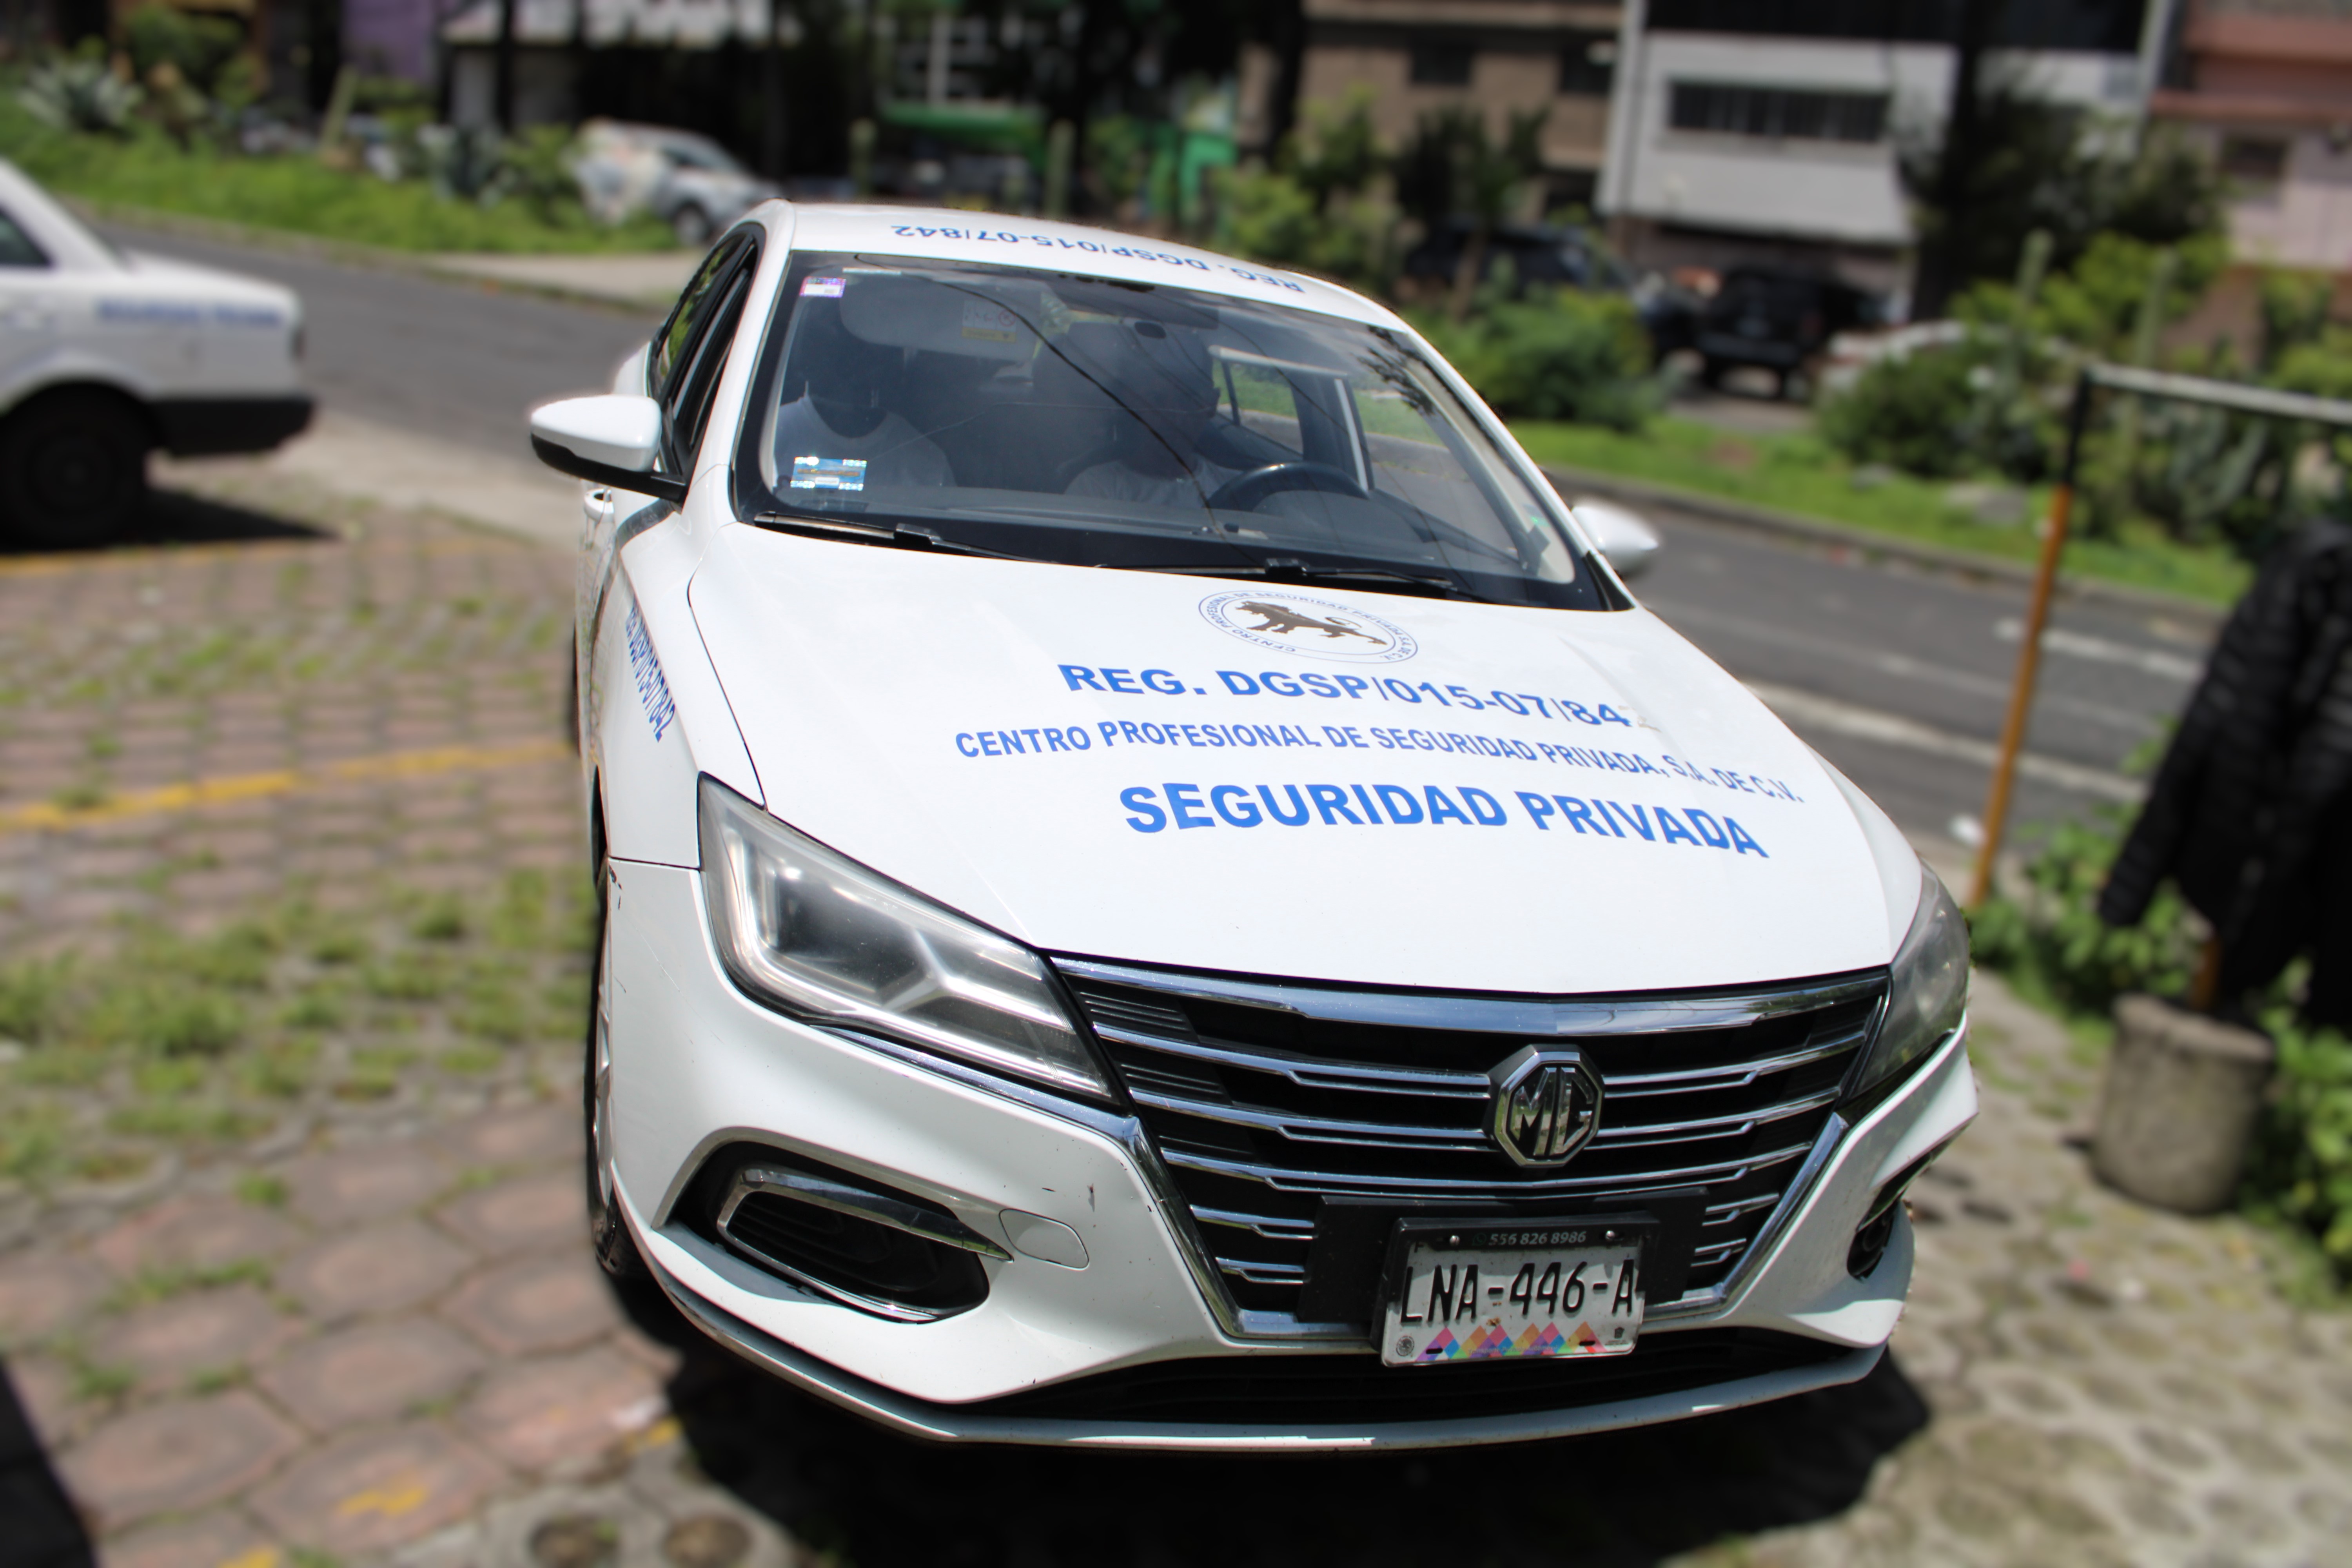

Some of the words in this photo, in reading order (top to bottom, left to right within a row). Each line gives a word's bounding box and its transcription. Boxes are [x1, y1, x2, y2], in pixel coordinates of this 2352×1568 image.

[890, 225, 1210, 270] DGSP/015-07/842
[1218, 263, 1305, 293] REG.
[1058, 664, 1207, 695] REG.
[1216, 671, 1662, 733] DGSP/015-07/84
[956, 726, 1091, 757] CENTRO
[1097, 720, 1322, 746] PROFESIONAL
[1321, 726, 1370, 748] DE
[1370, 728, 1538, 760] SEGURIDAD
[1535, 742, 1671, 777] PRIVADA,
[1662, 755, 1719, 786] S.A.
[1710, 768, 1756, 793] DE
[1749, 775, 1805, 802] C.V.
[1120, 783, 1508, 833] SEGURIDAD
[1514, 791, 1770, 858] PRIVADA
[1510, 1067, 1594, 1156] MG
[1488, 1233, 1517, 1245] 556
[1520, 1232, 1548, 1245] 826
[1550, 1231, 1587, 1244] 8986
[1400, 1259, 1634, 1324] LNA-446-A
